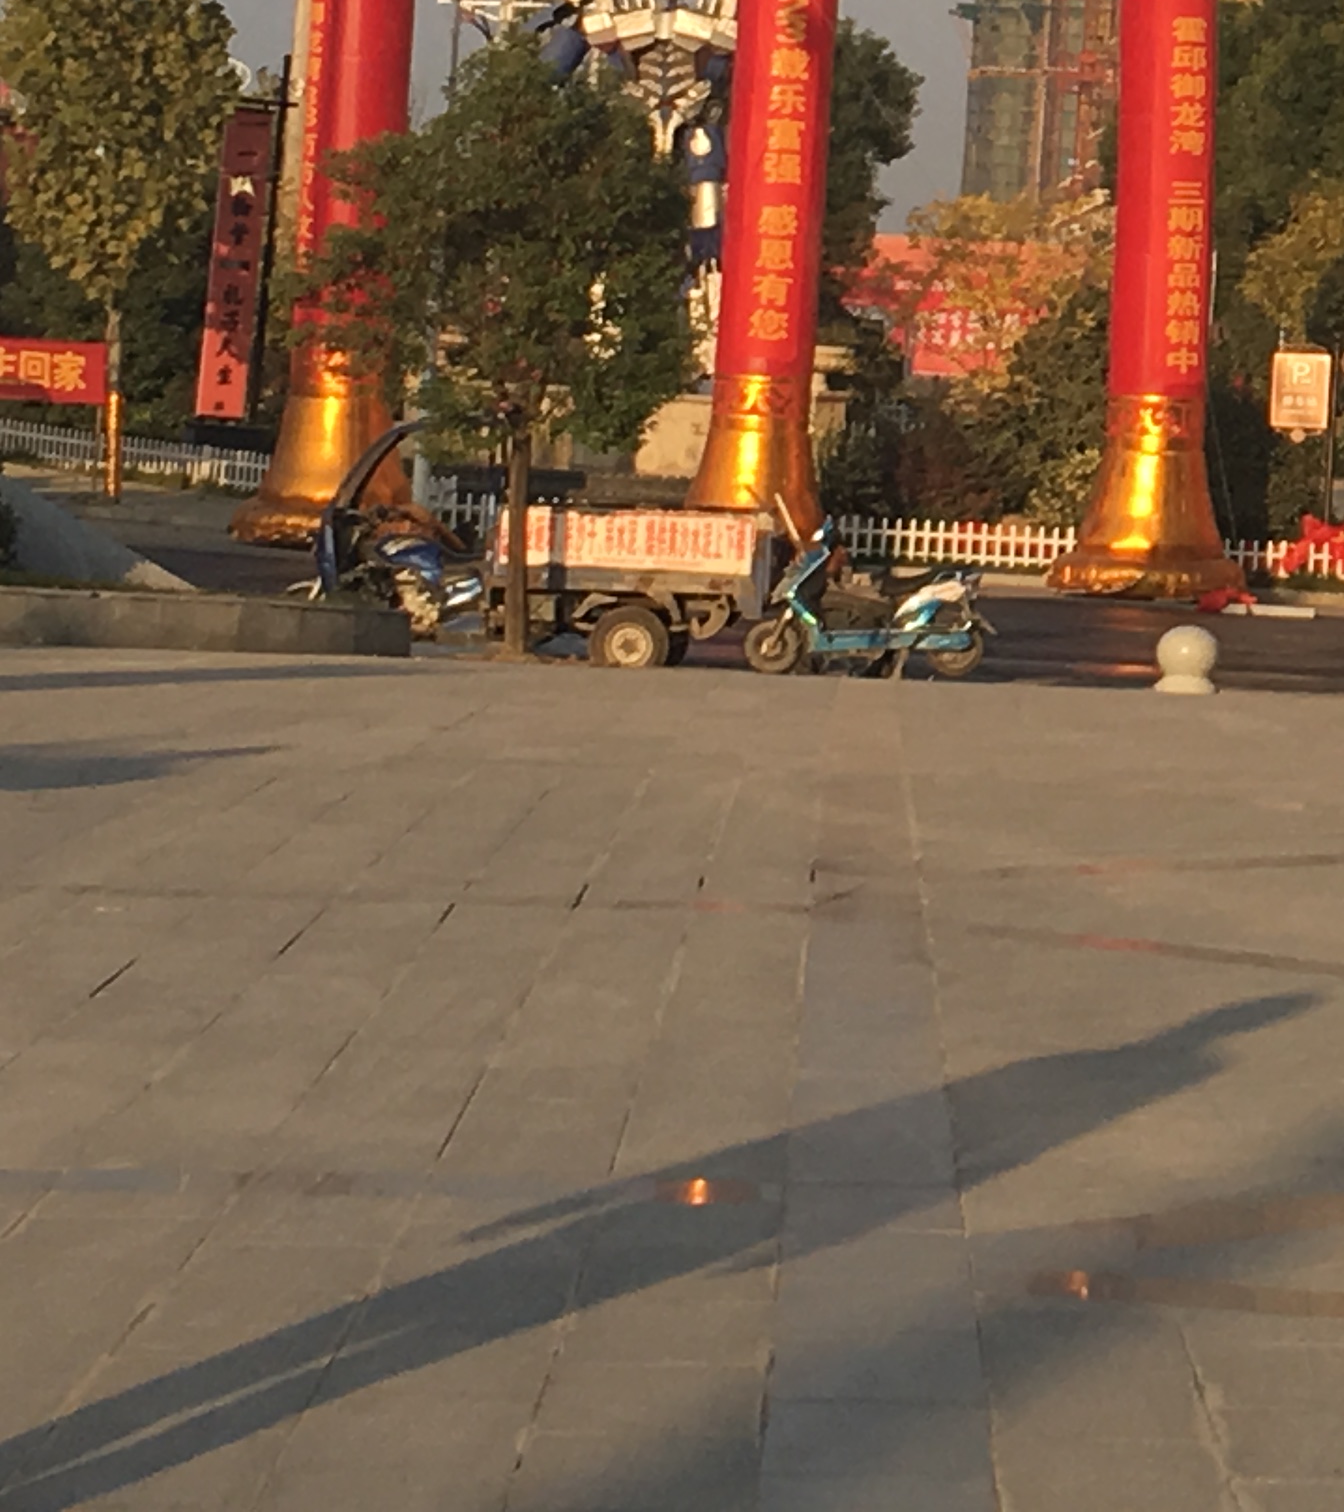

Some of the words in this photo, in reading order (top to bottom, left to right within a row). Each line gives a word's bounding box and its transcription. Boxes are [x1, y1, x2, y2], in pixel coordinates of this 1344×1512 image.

[1169, 16, 1207, 157] 霍邱御龙湾
[747, 203, 799, 341] 感恩有您
[1164, 180, 1205, 375] 三期新品热销中
